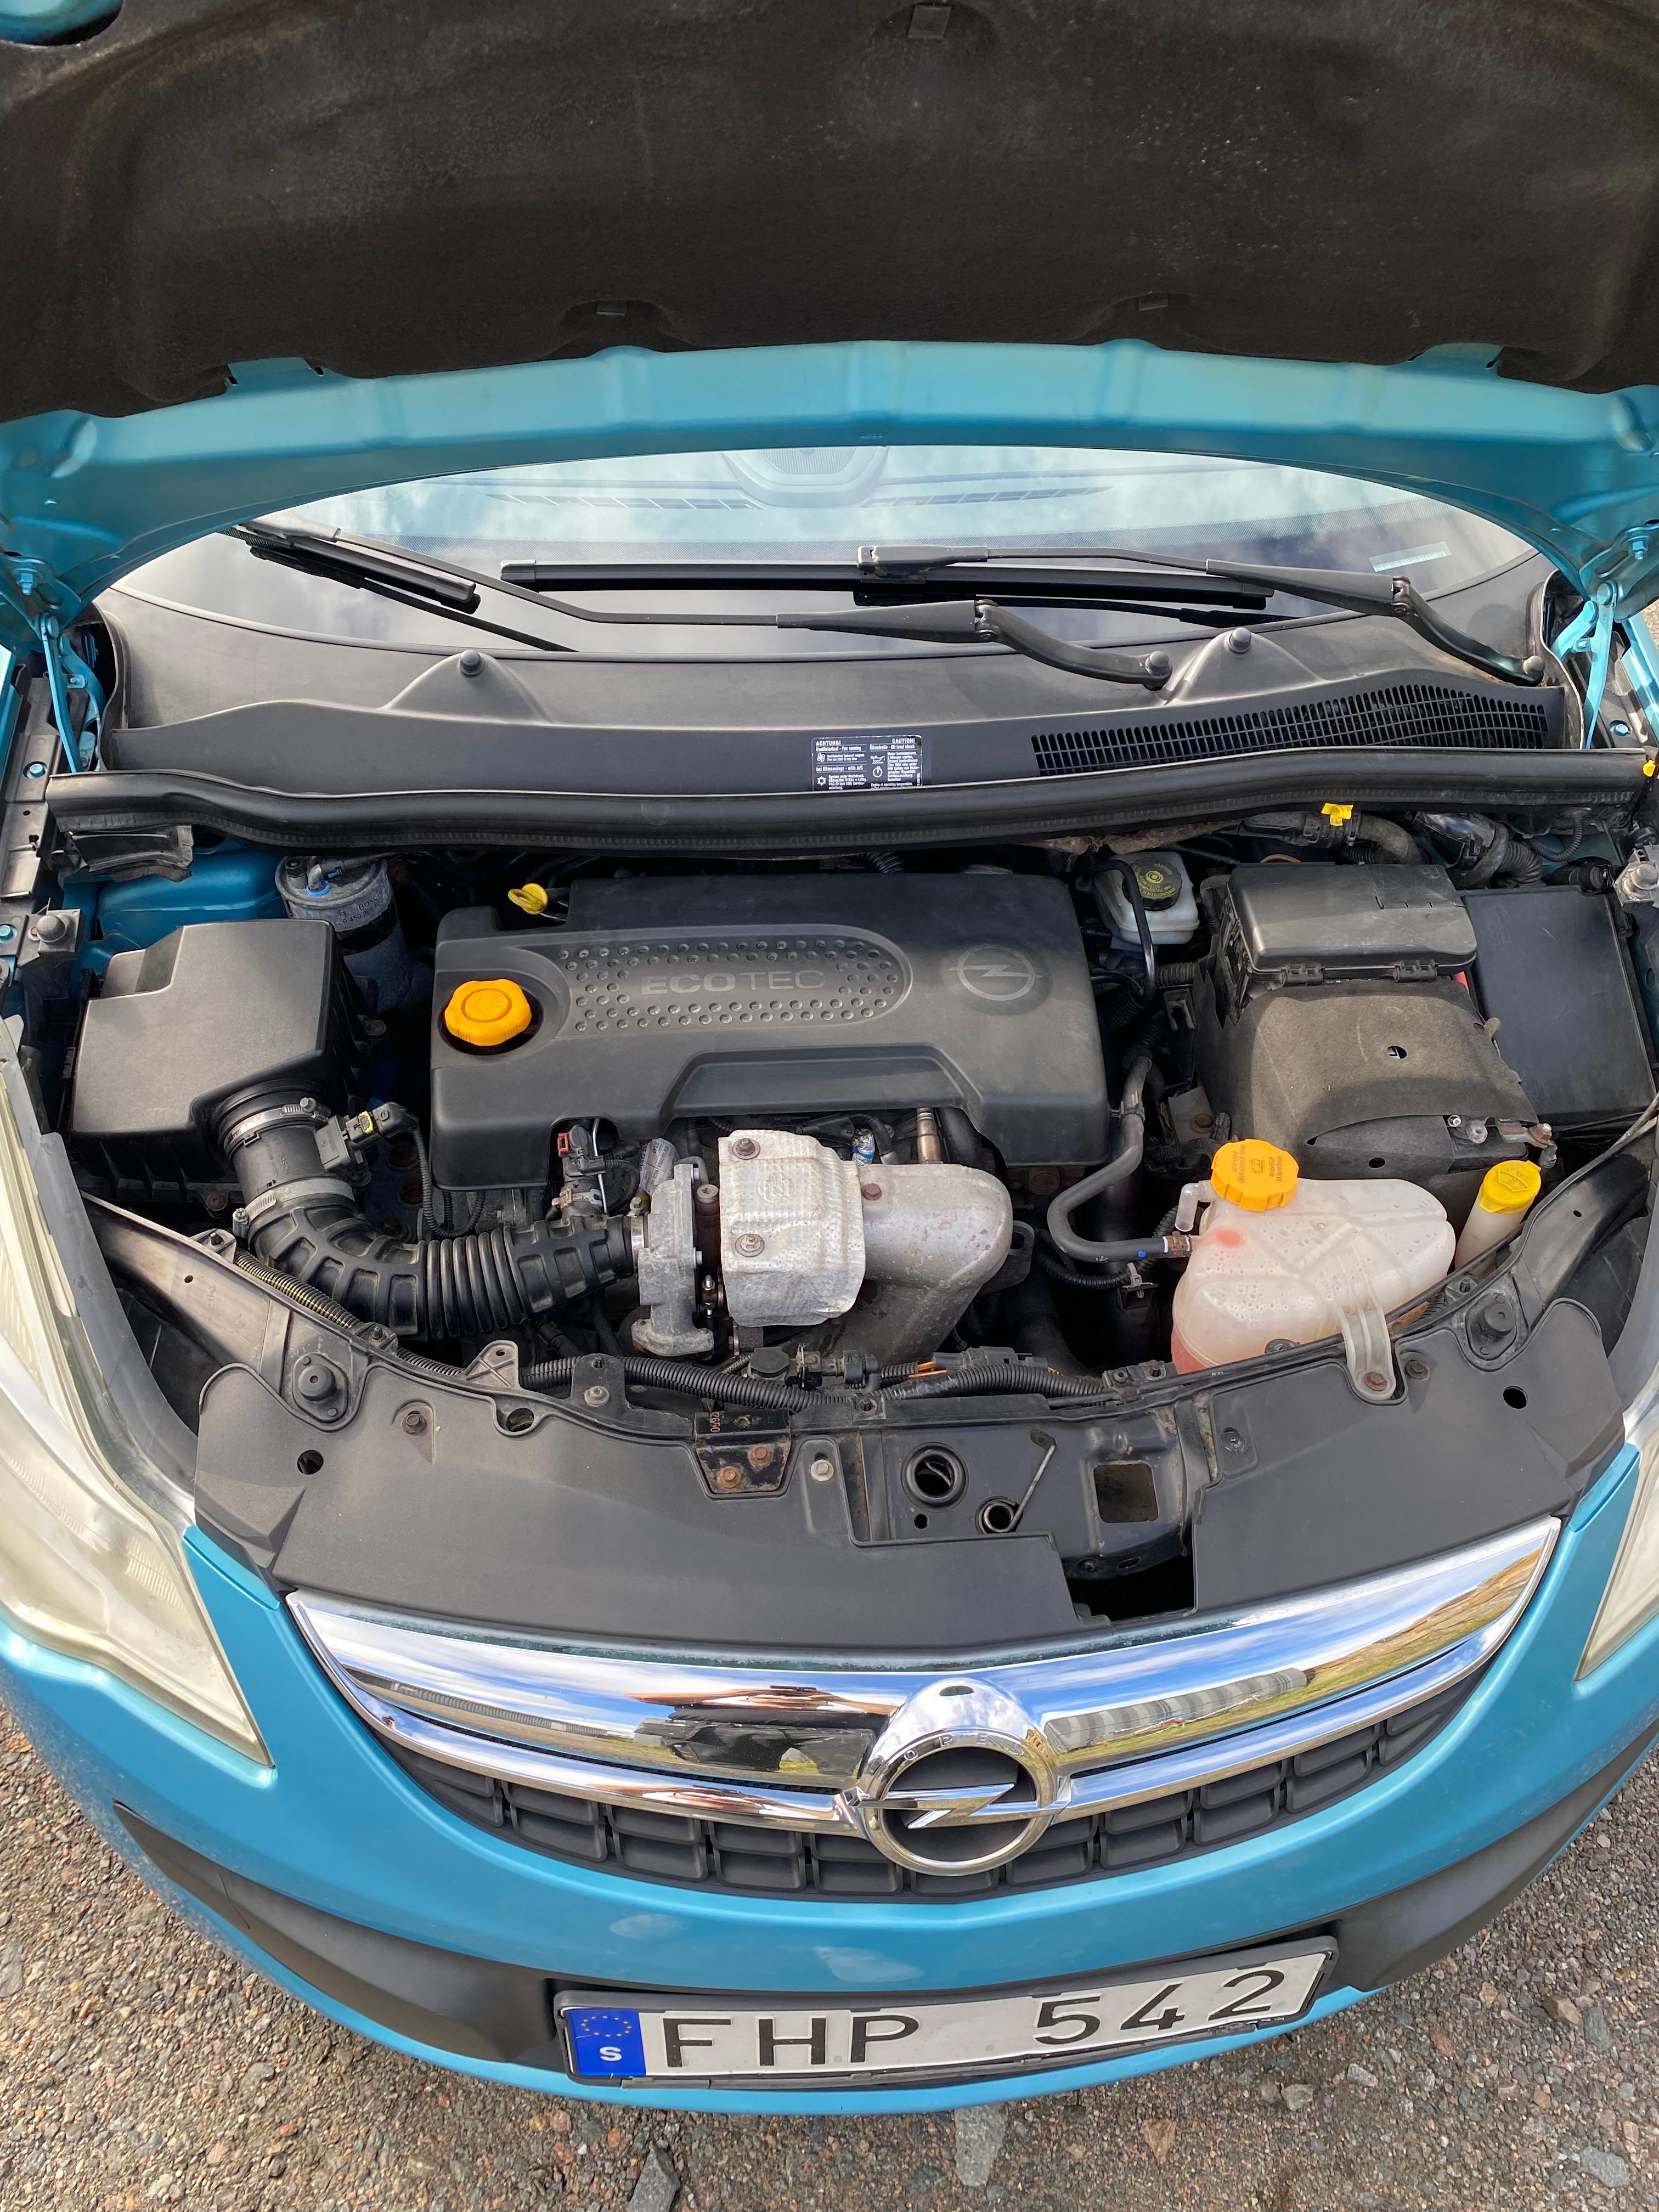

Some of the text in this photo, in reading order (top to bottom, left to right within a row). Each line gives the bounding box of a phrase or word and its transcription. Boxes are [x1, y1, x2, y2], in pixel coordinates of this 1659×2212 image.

[641, 969, 825, 996] ECOTEC
[279, 1150, 290, 1175] BOSCH
[663, 1970, 1285, 2068] FHP 542
[600, 2047, 622, 2062] S
